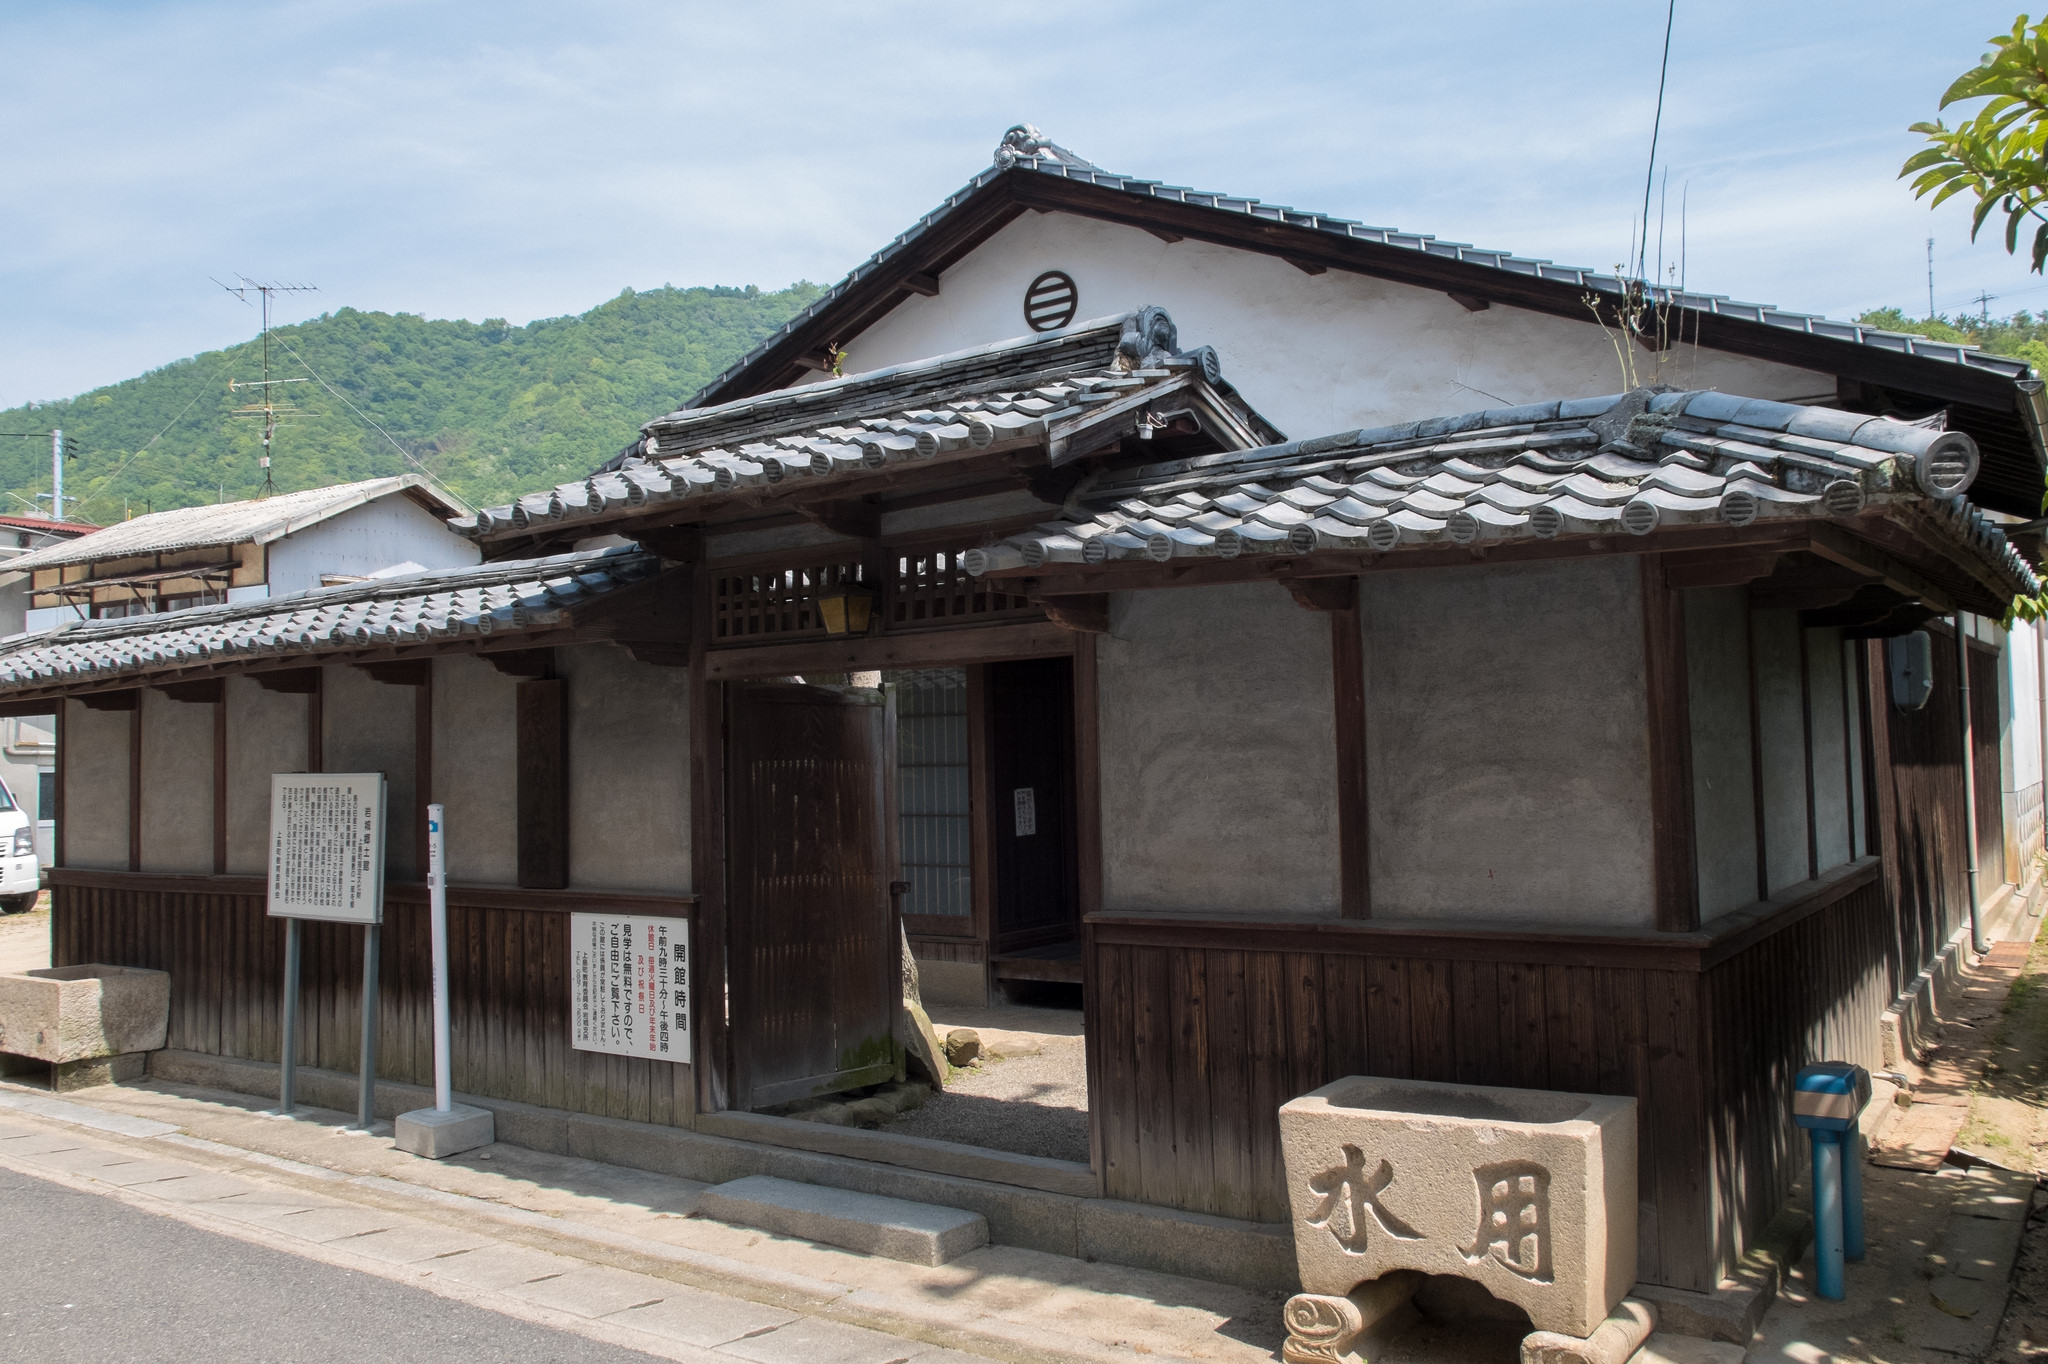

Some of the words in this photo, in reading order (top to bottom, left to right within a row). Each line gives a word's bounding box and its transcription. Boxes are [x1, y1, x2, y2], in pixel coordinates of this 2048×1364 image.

[610, 923, 620, 1045] ご自由にご覧下さい。
[623, 924, 633, 1046] 見学は無料ですので、
[648, 956, 656, 1051] 毎週火曜日及び年末年始
[674, 944, 686, 1031] 開館時間
